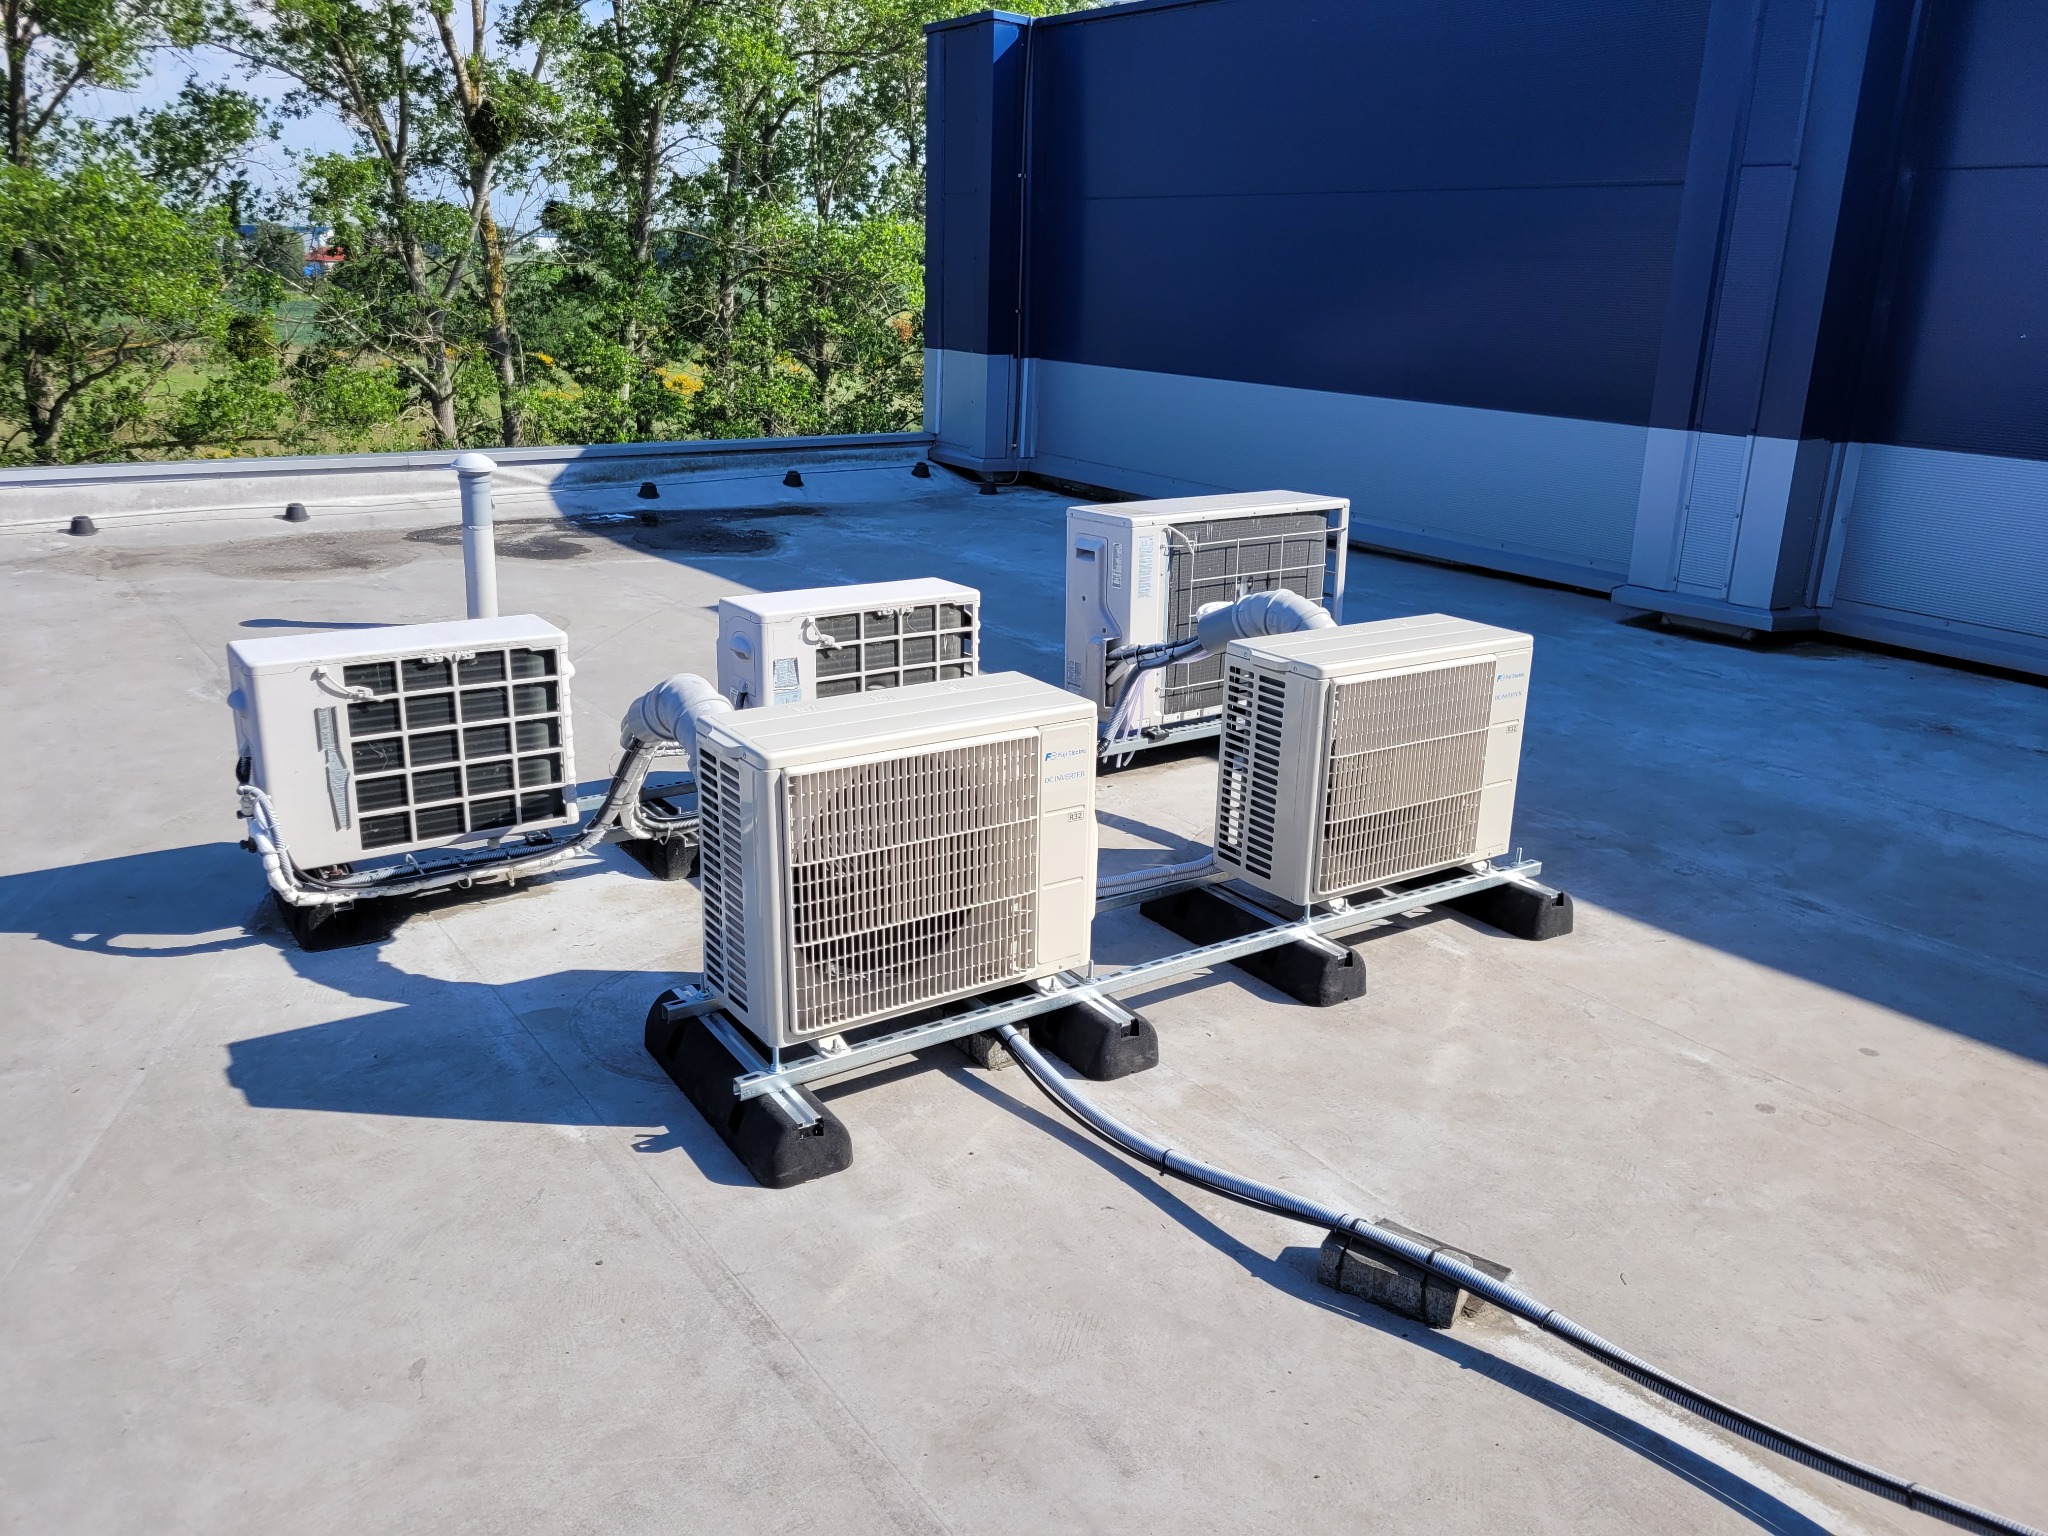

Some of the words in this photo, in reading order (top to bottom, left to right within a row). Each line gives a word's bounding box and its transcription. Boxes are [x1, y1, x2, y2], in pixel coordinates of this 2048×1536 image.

[1044, 776, 1054, 784] DC
[1054, 771, 1085, 782] INVERTER
[1069, 812, 1083, 821] R32
